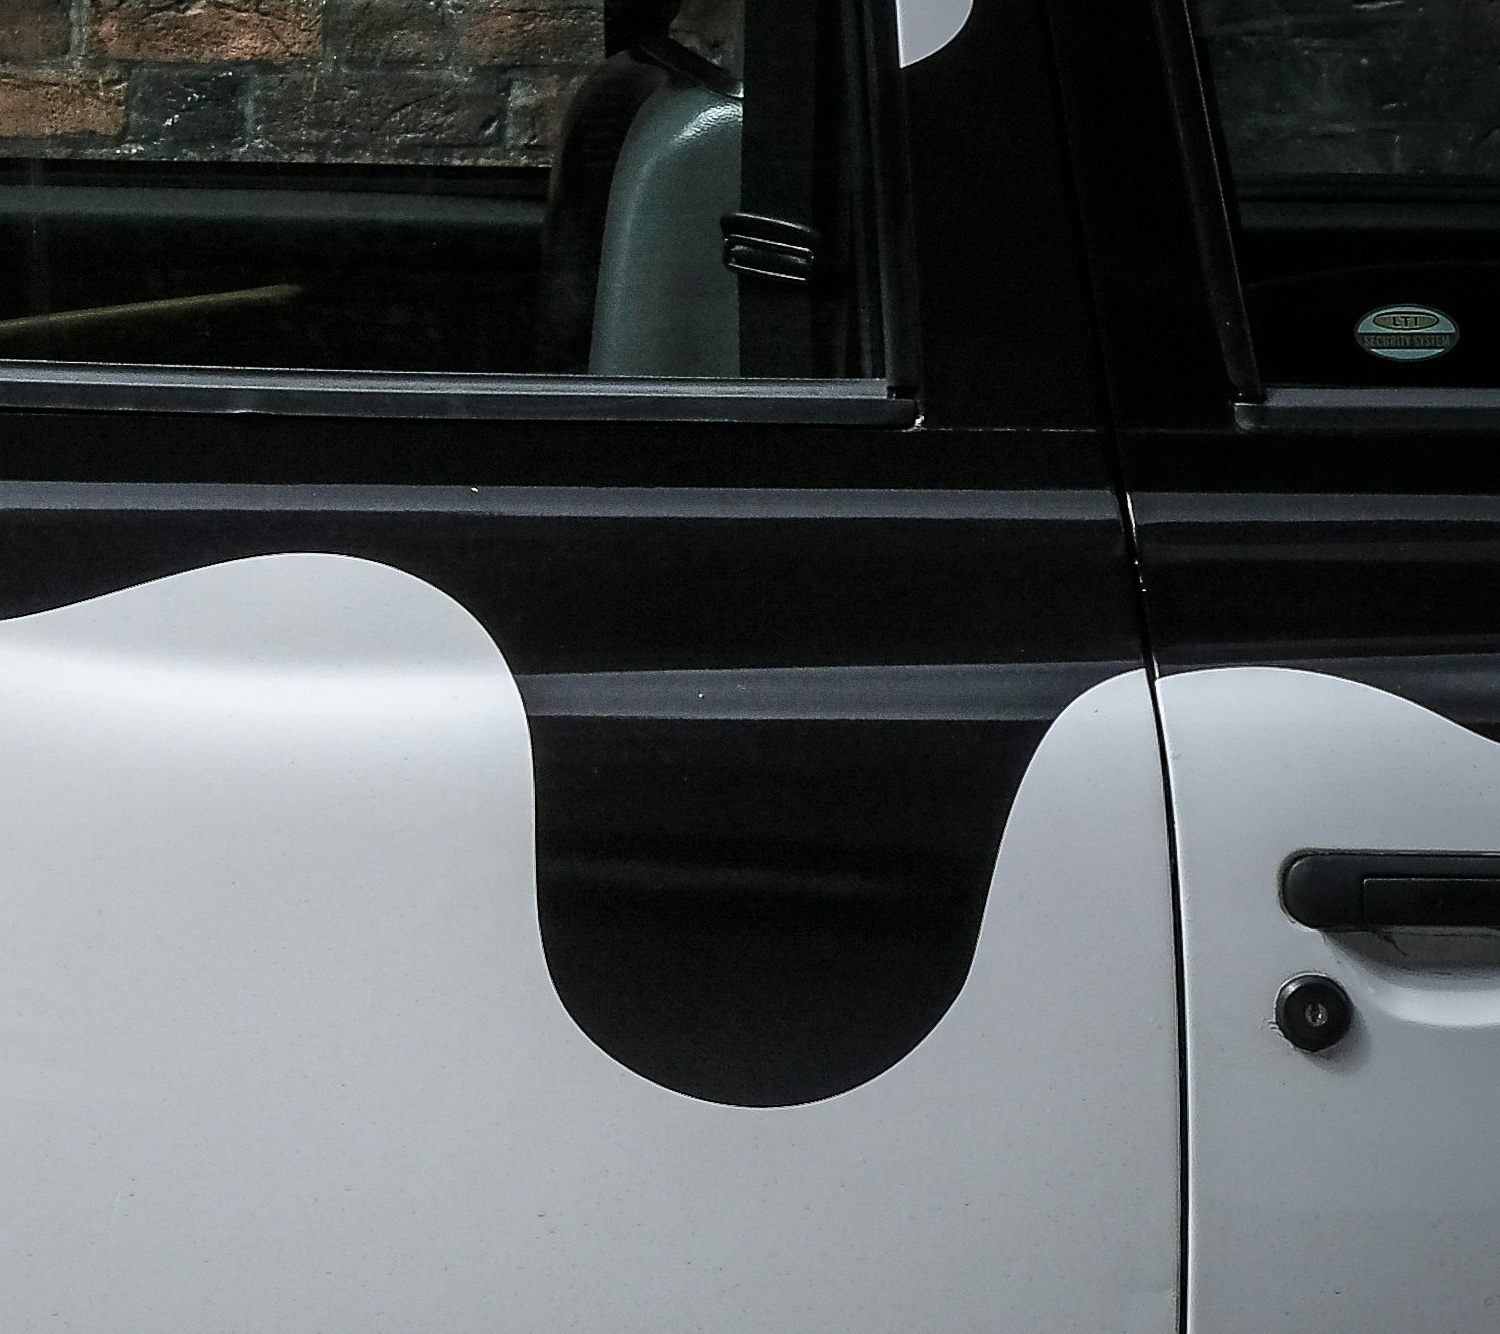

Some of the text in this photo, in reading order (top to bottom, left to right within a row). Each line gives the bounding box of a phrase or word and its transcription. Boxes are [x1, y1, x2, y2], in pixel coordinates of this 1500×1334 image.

[1392, 316, 1419, 327] LTI
[1364, 335, 1451, 348] SECURITY SYSTEM
